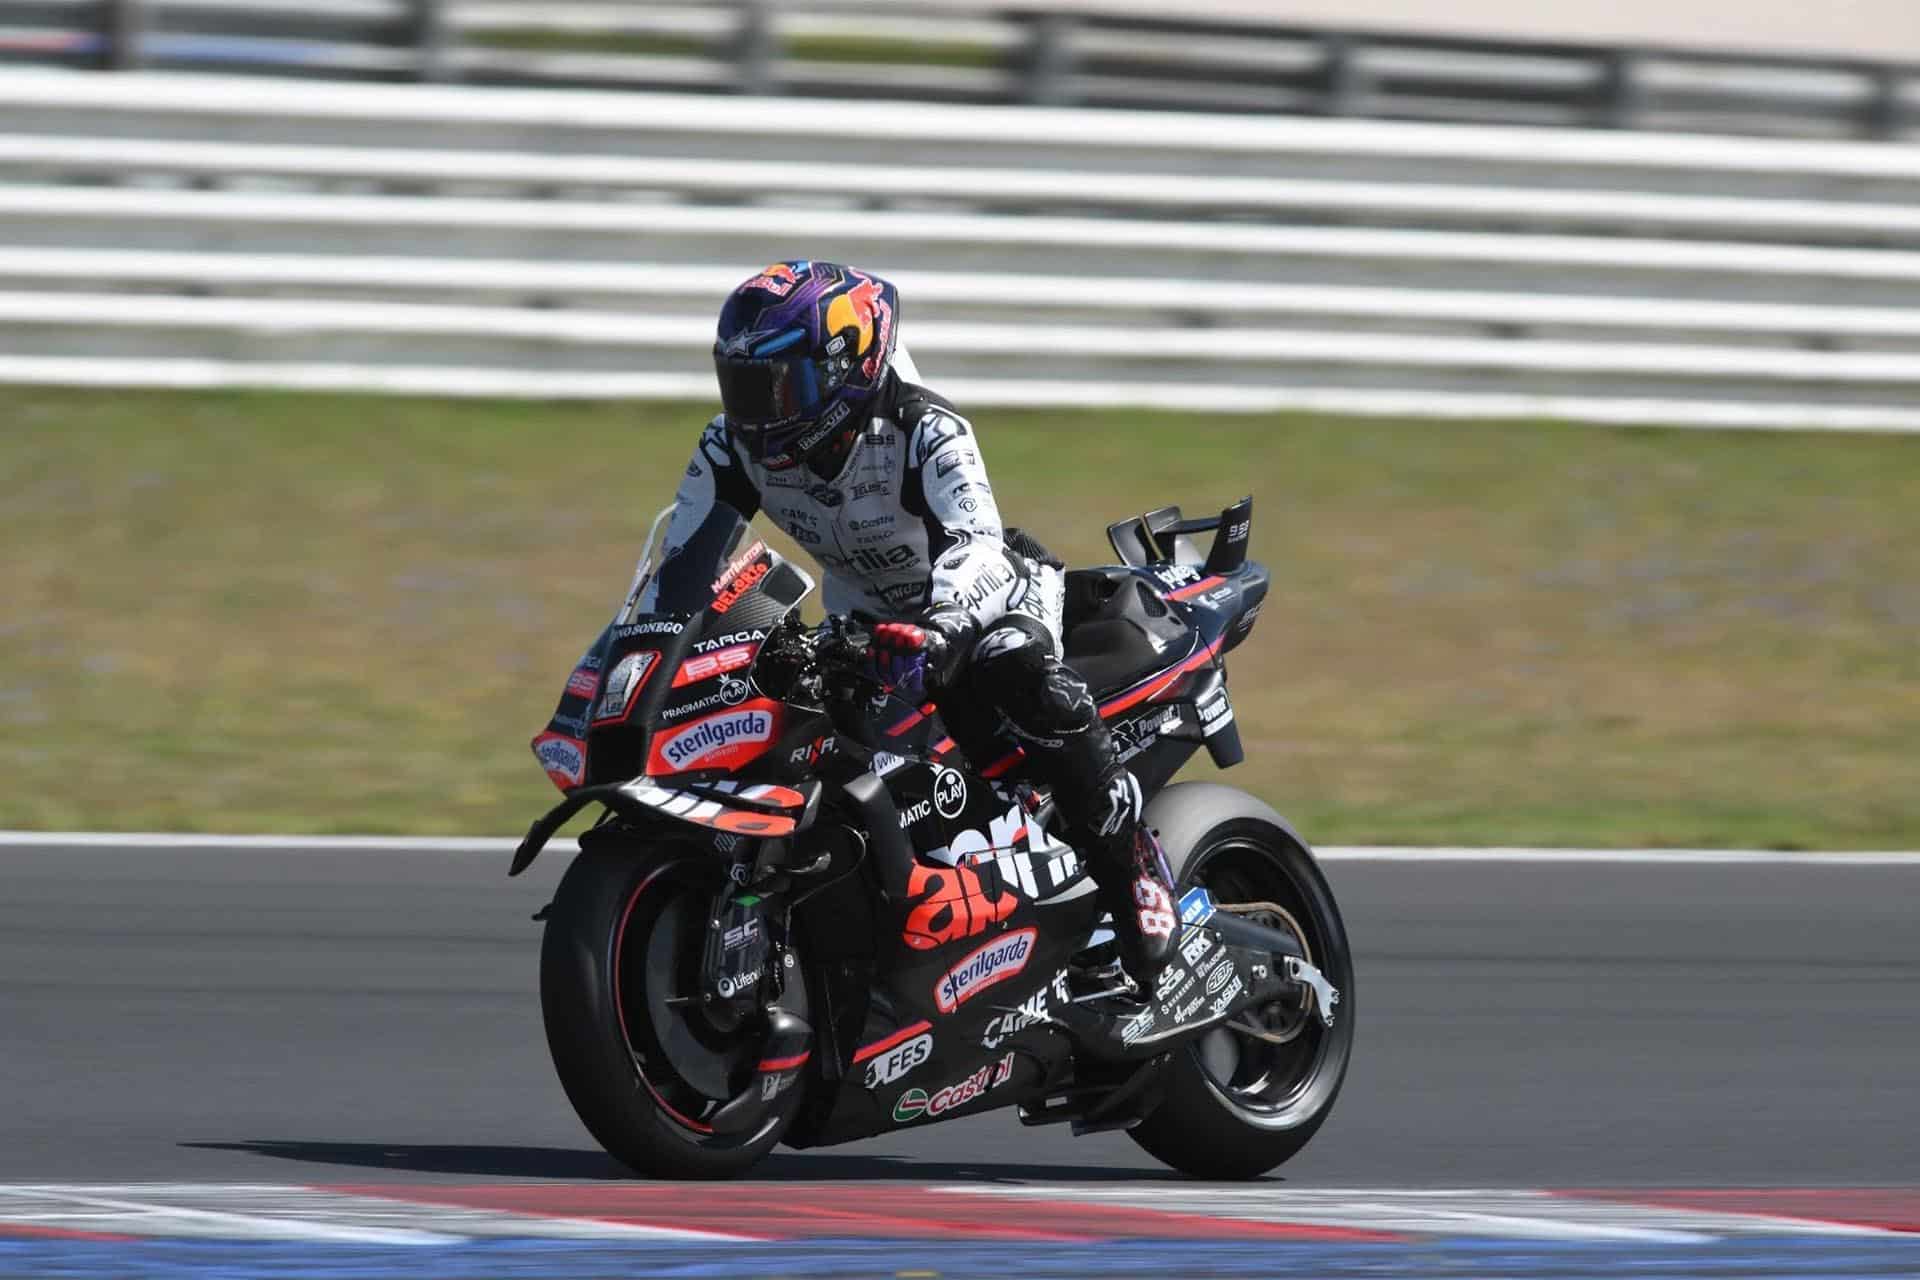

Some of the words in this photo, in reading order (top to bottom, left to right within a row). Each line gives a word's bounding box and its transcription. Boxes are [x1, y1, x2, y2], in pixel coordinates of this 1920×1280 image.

[693, 629, 766, 653] TARGA
[662, 695, 721, 720] PRAGMATIC
[723, 684, 746, 699] PLAY
[668, 712, 766, 763] sterilgarda
[937, 781, 963, 807] PLAY
[943, 935, 1029, 1001] sterilgarda
[886, 1040, 928, 1077] FES
